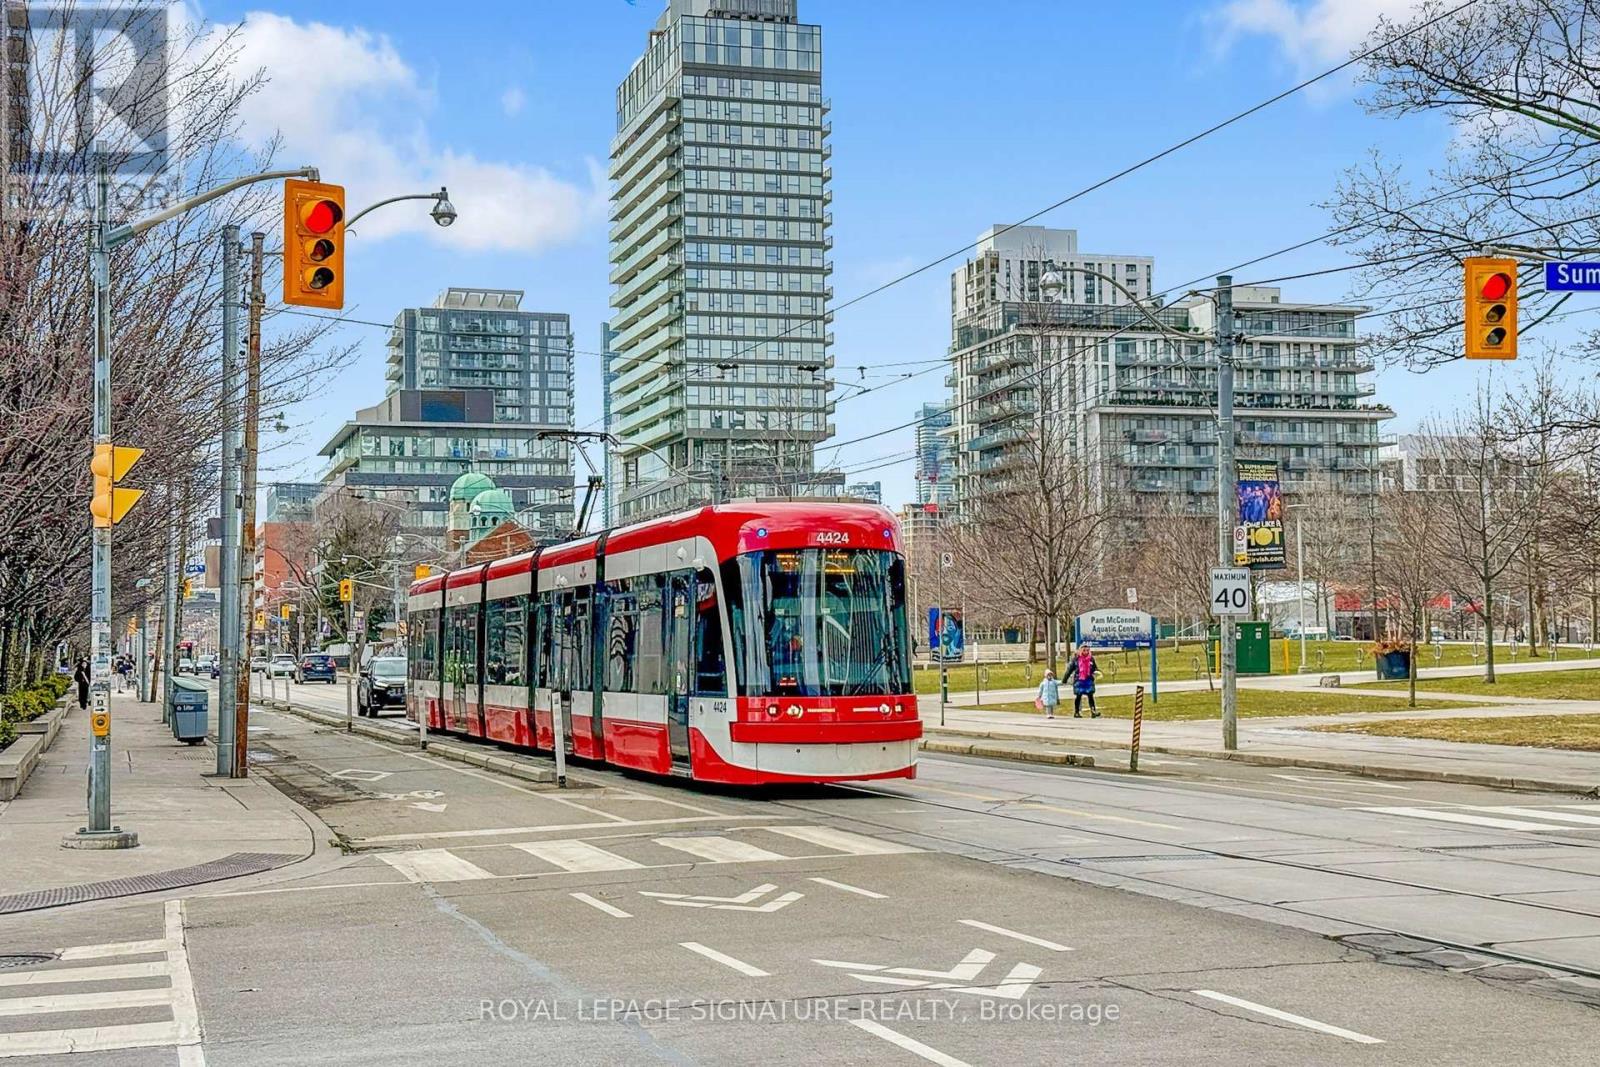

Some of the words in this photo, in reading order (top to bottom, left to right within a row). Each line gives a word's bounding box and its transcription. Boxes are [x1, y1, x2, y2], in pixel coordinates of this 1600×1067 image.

[1558, 264, 1600, 284] Sum
[816, 532, 850, 544] 4424
[1246, 527, 1282, 546] HOT
[1214, 588, 1247, 608] 40
[1091, 616, 1105, 624] Pam
[1106, 616, 1140, 624] McConnell
[1092, 625, 1117, 633] Aquatic
[713, 701, 727, 713] 4424
